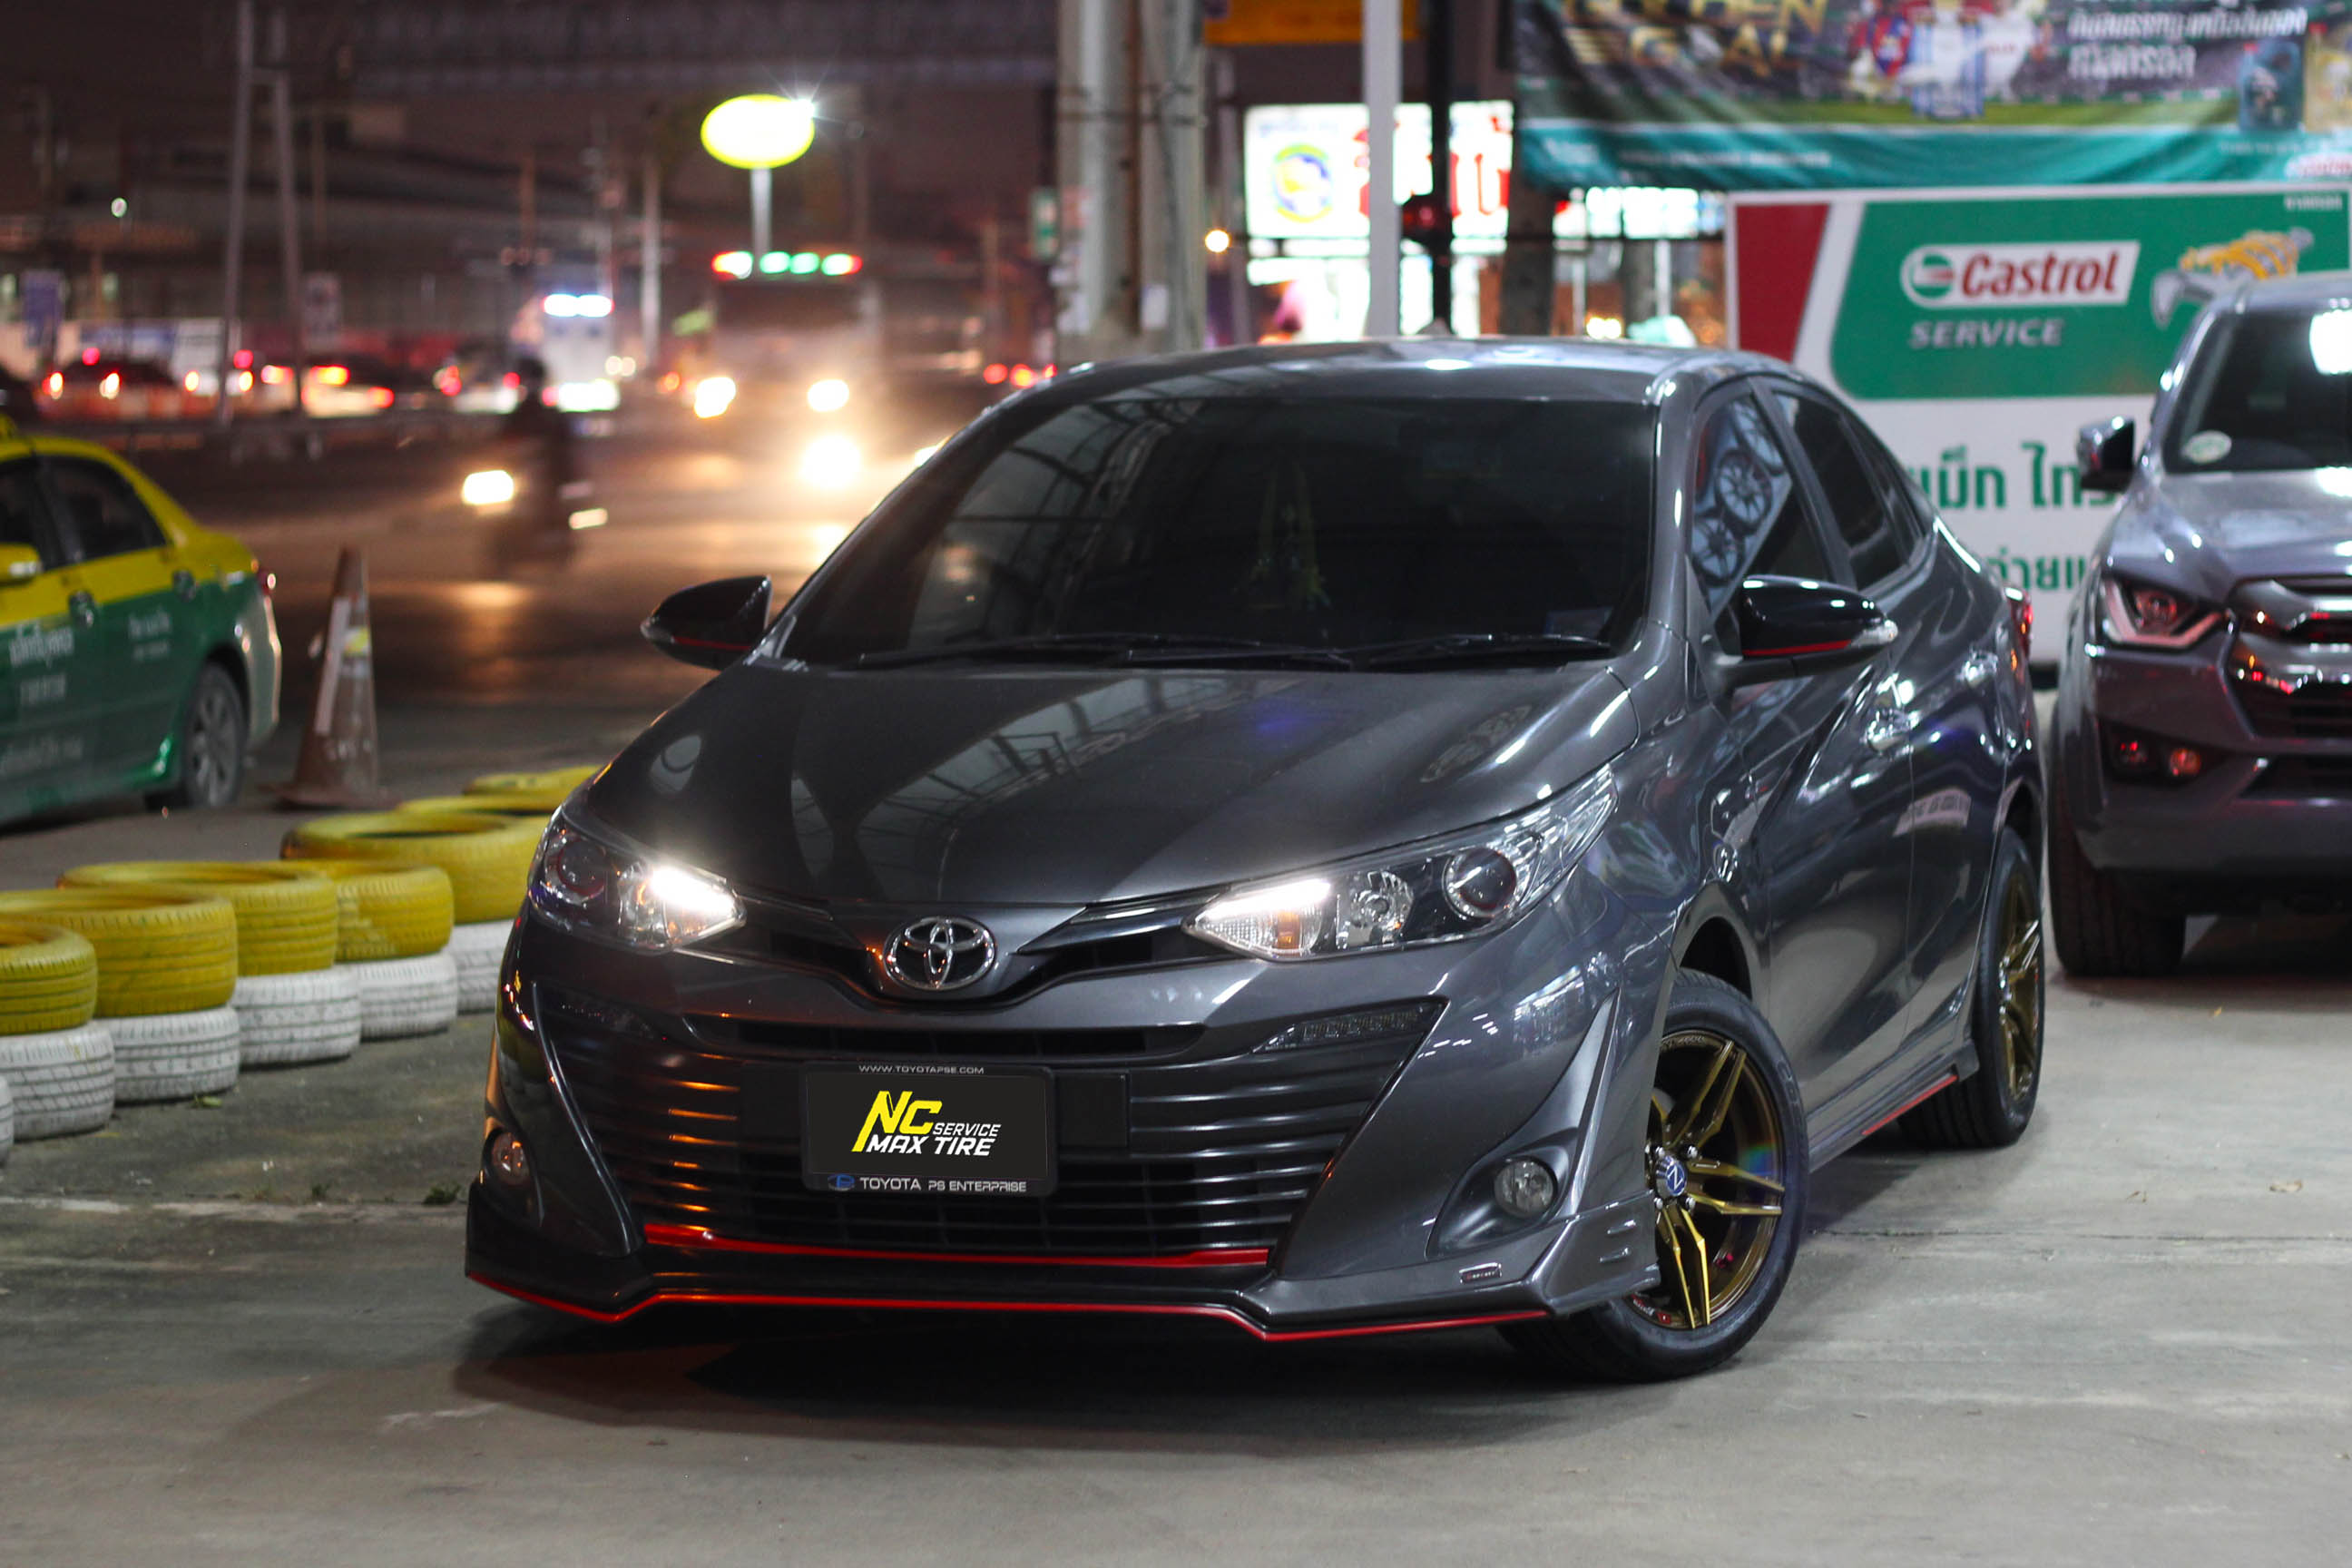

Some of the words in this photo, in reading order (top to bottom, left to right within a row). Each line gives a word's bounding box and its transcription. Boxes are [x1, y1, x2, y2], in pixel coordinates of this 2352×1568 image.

[1962, 251, 2118, 298] Castrol
[1910, 318, 2063, 348] SERVICE
[859, 1177, 921, 1191] TOYOTA
[948, 1180, 1027, 1192] ENTERPRISE
